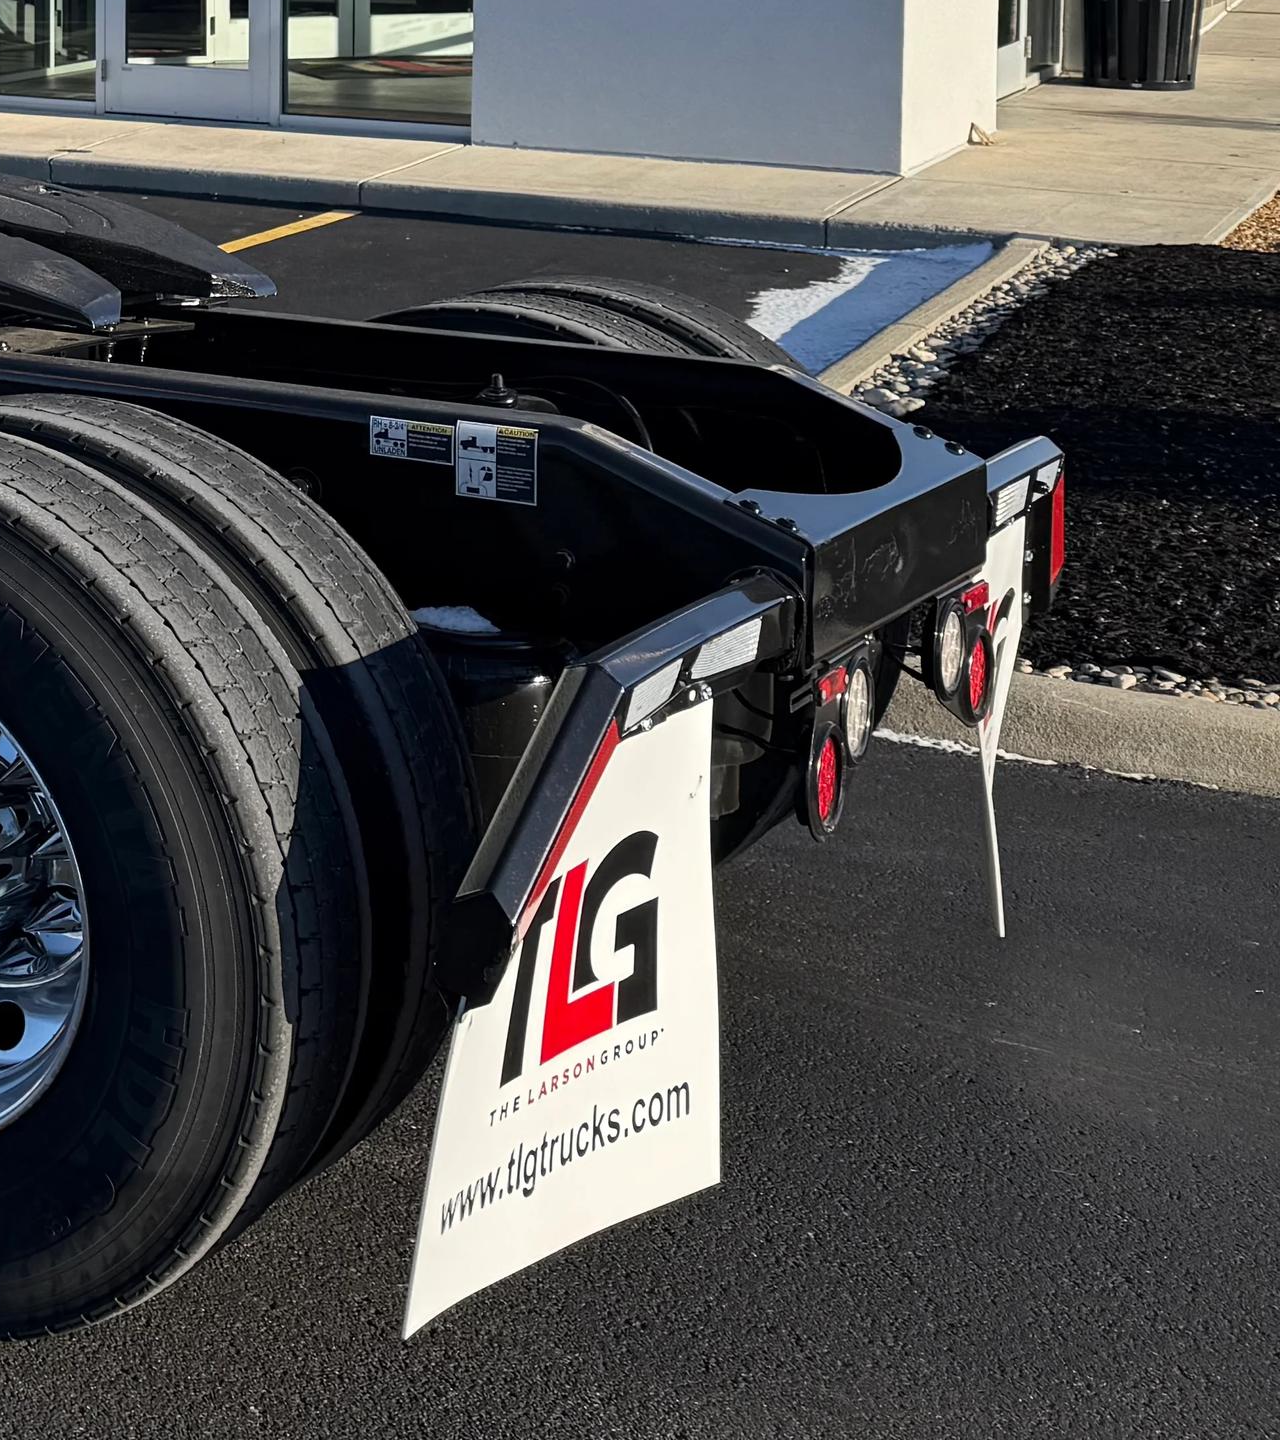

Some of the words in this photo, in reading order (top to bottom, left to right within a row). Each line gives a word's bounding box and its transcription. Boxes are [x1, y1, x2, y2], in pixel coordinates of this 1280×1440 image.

[374, 445, 406, 456] UNLADEN
[411, 424, 448, 433] ATTENTION
[504, 428, 536, 438] CAUTION
[499, 829, 660, 1089] TLG
[489, 1096, 521, 1127] THE
[528, 1055, 595, 1105] LARSON
[600, 1030, 660, 1066] GROUP
[441, 1081, 691, 1236] www.tlgtrucks.com
